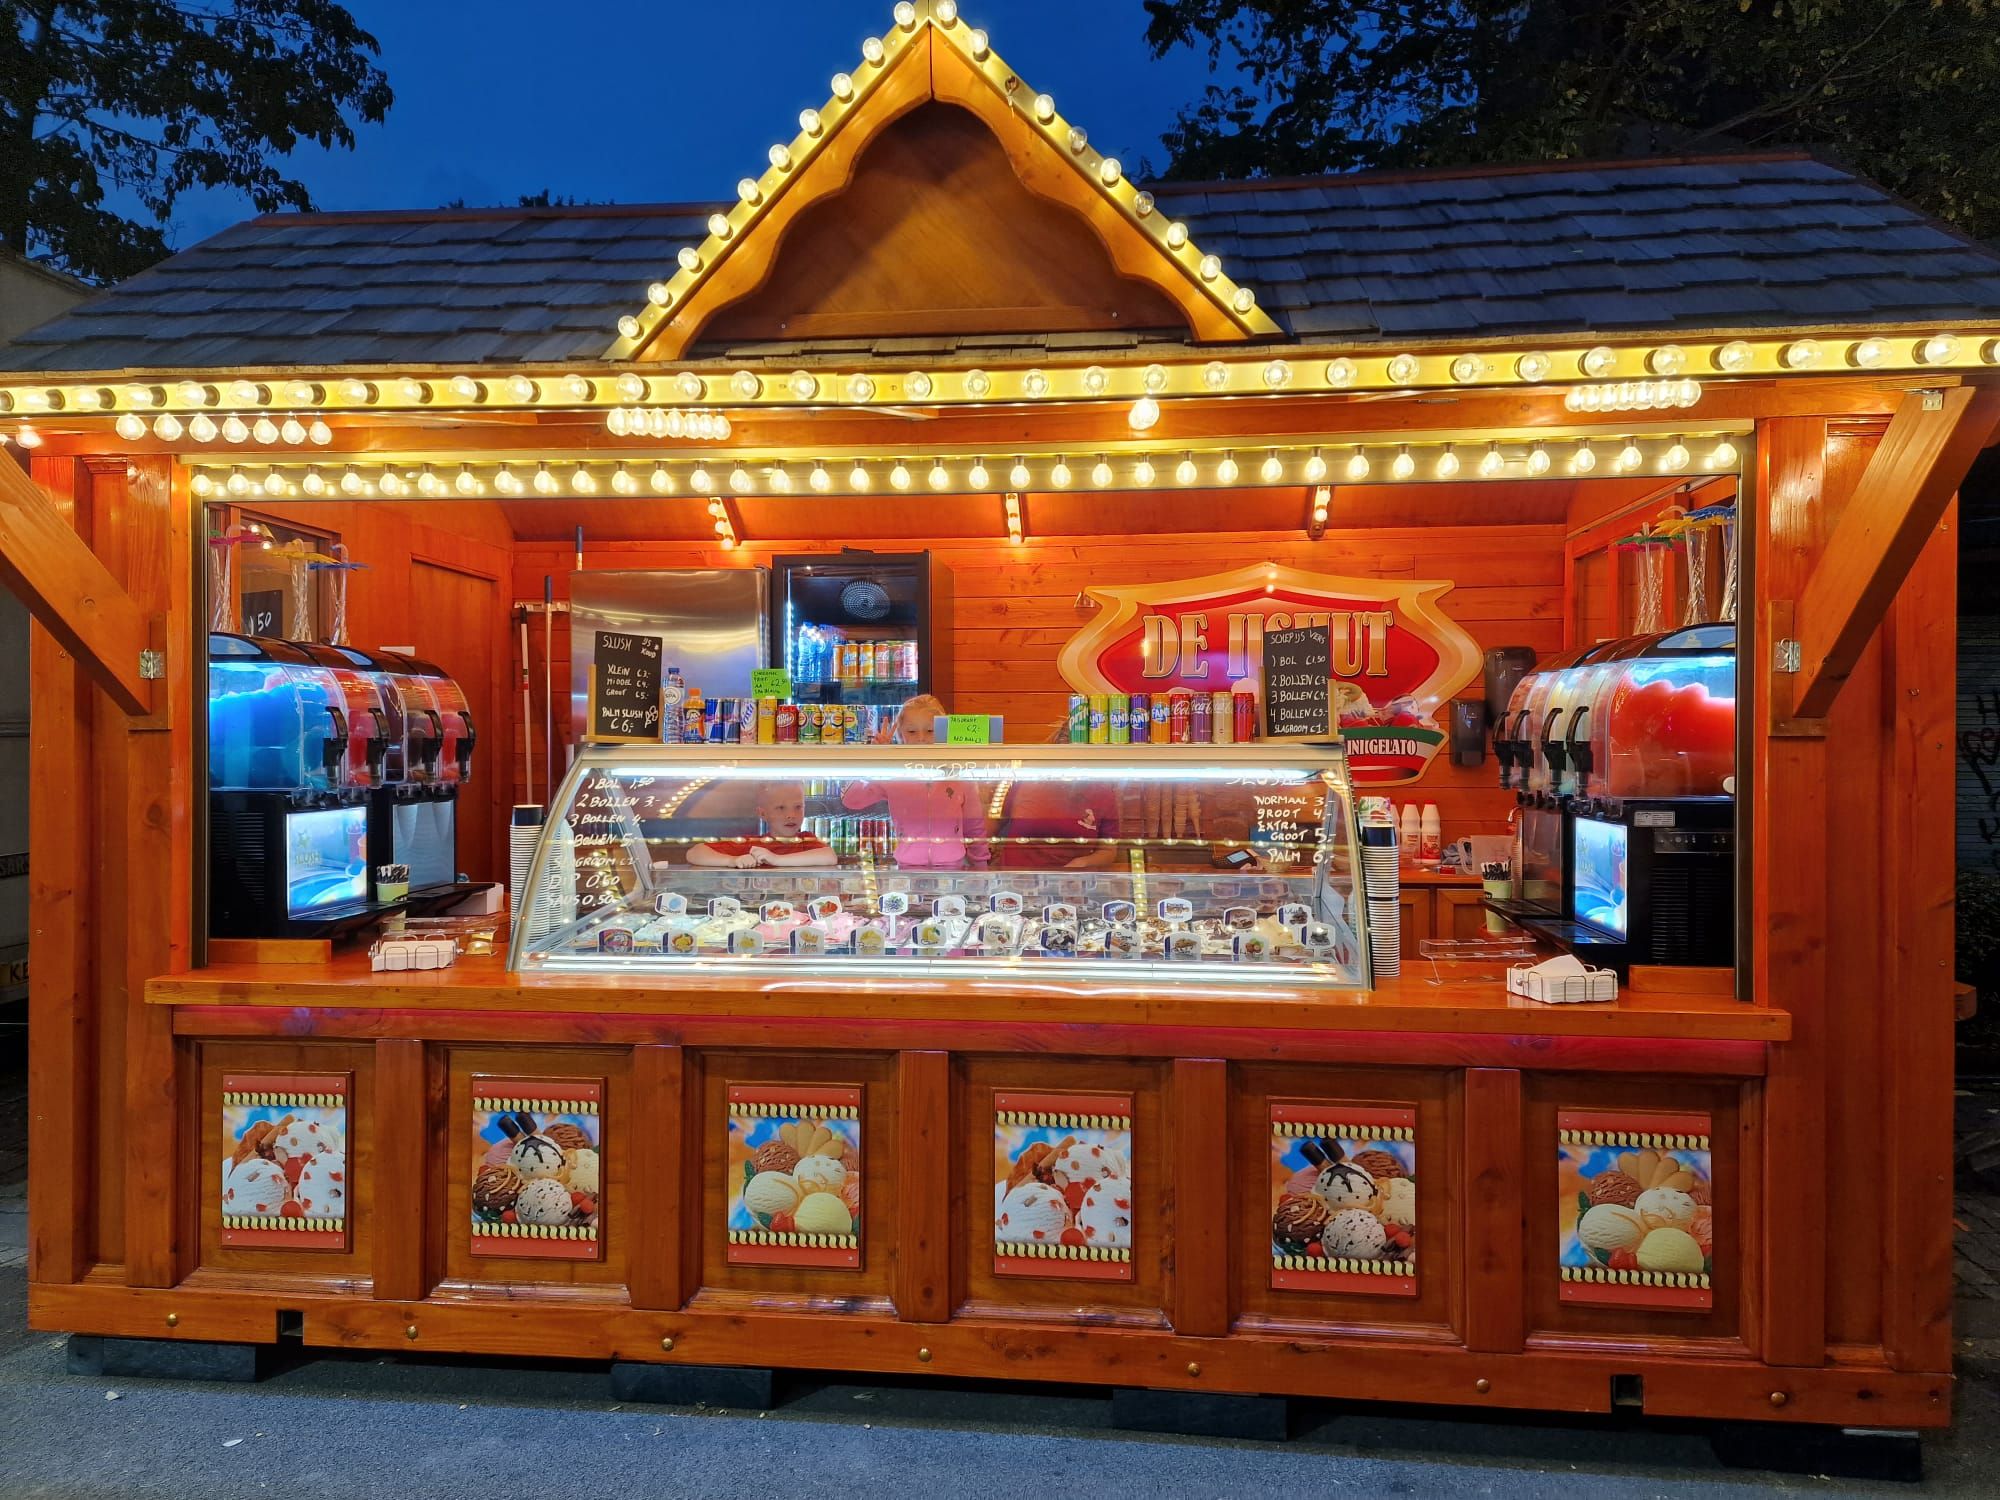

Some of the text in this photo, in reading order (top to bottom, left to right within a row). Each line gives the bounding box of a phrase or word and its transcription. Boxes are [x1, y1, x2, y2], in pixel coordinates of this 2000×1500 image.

[602, 634, 632, 651] SLUSH
[1142, 613, 1208, 678] DE
[1280, 655, 1297, 666] BOL
[1271, 675, 1277, 687] 2
[1280, 674, 1313, 687] BOLLEN
[1271, 690, 1277, 704] 3
[1280, 691, 1313, 703] BOLLEN
[602, 706, 643, 719] PALM SLUSH
[1270, 708, 1276, 723] 4
[1280, 707, 1311, 721] BOLLEN
[1274, 724, 1308, 734] SLAGROOM
[1368, 738, 1417, 757] GELATO
[595, 778, 620, 790] BOL
[576, 793, 589, 808] 2
[589, 796, 640, 808] BOLLEN
[1254, 795, 1308, 806] NORMAAL
[569, 813, 580, 828] 3
[581, 813, 626, 825] BOLLEN
[1257, 820, 1297, 833] EXTRA
[1270, 829, 1310, 841] GROOT
[1267, 848, 1301, 863] PALM
